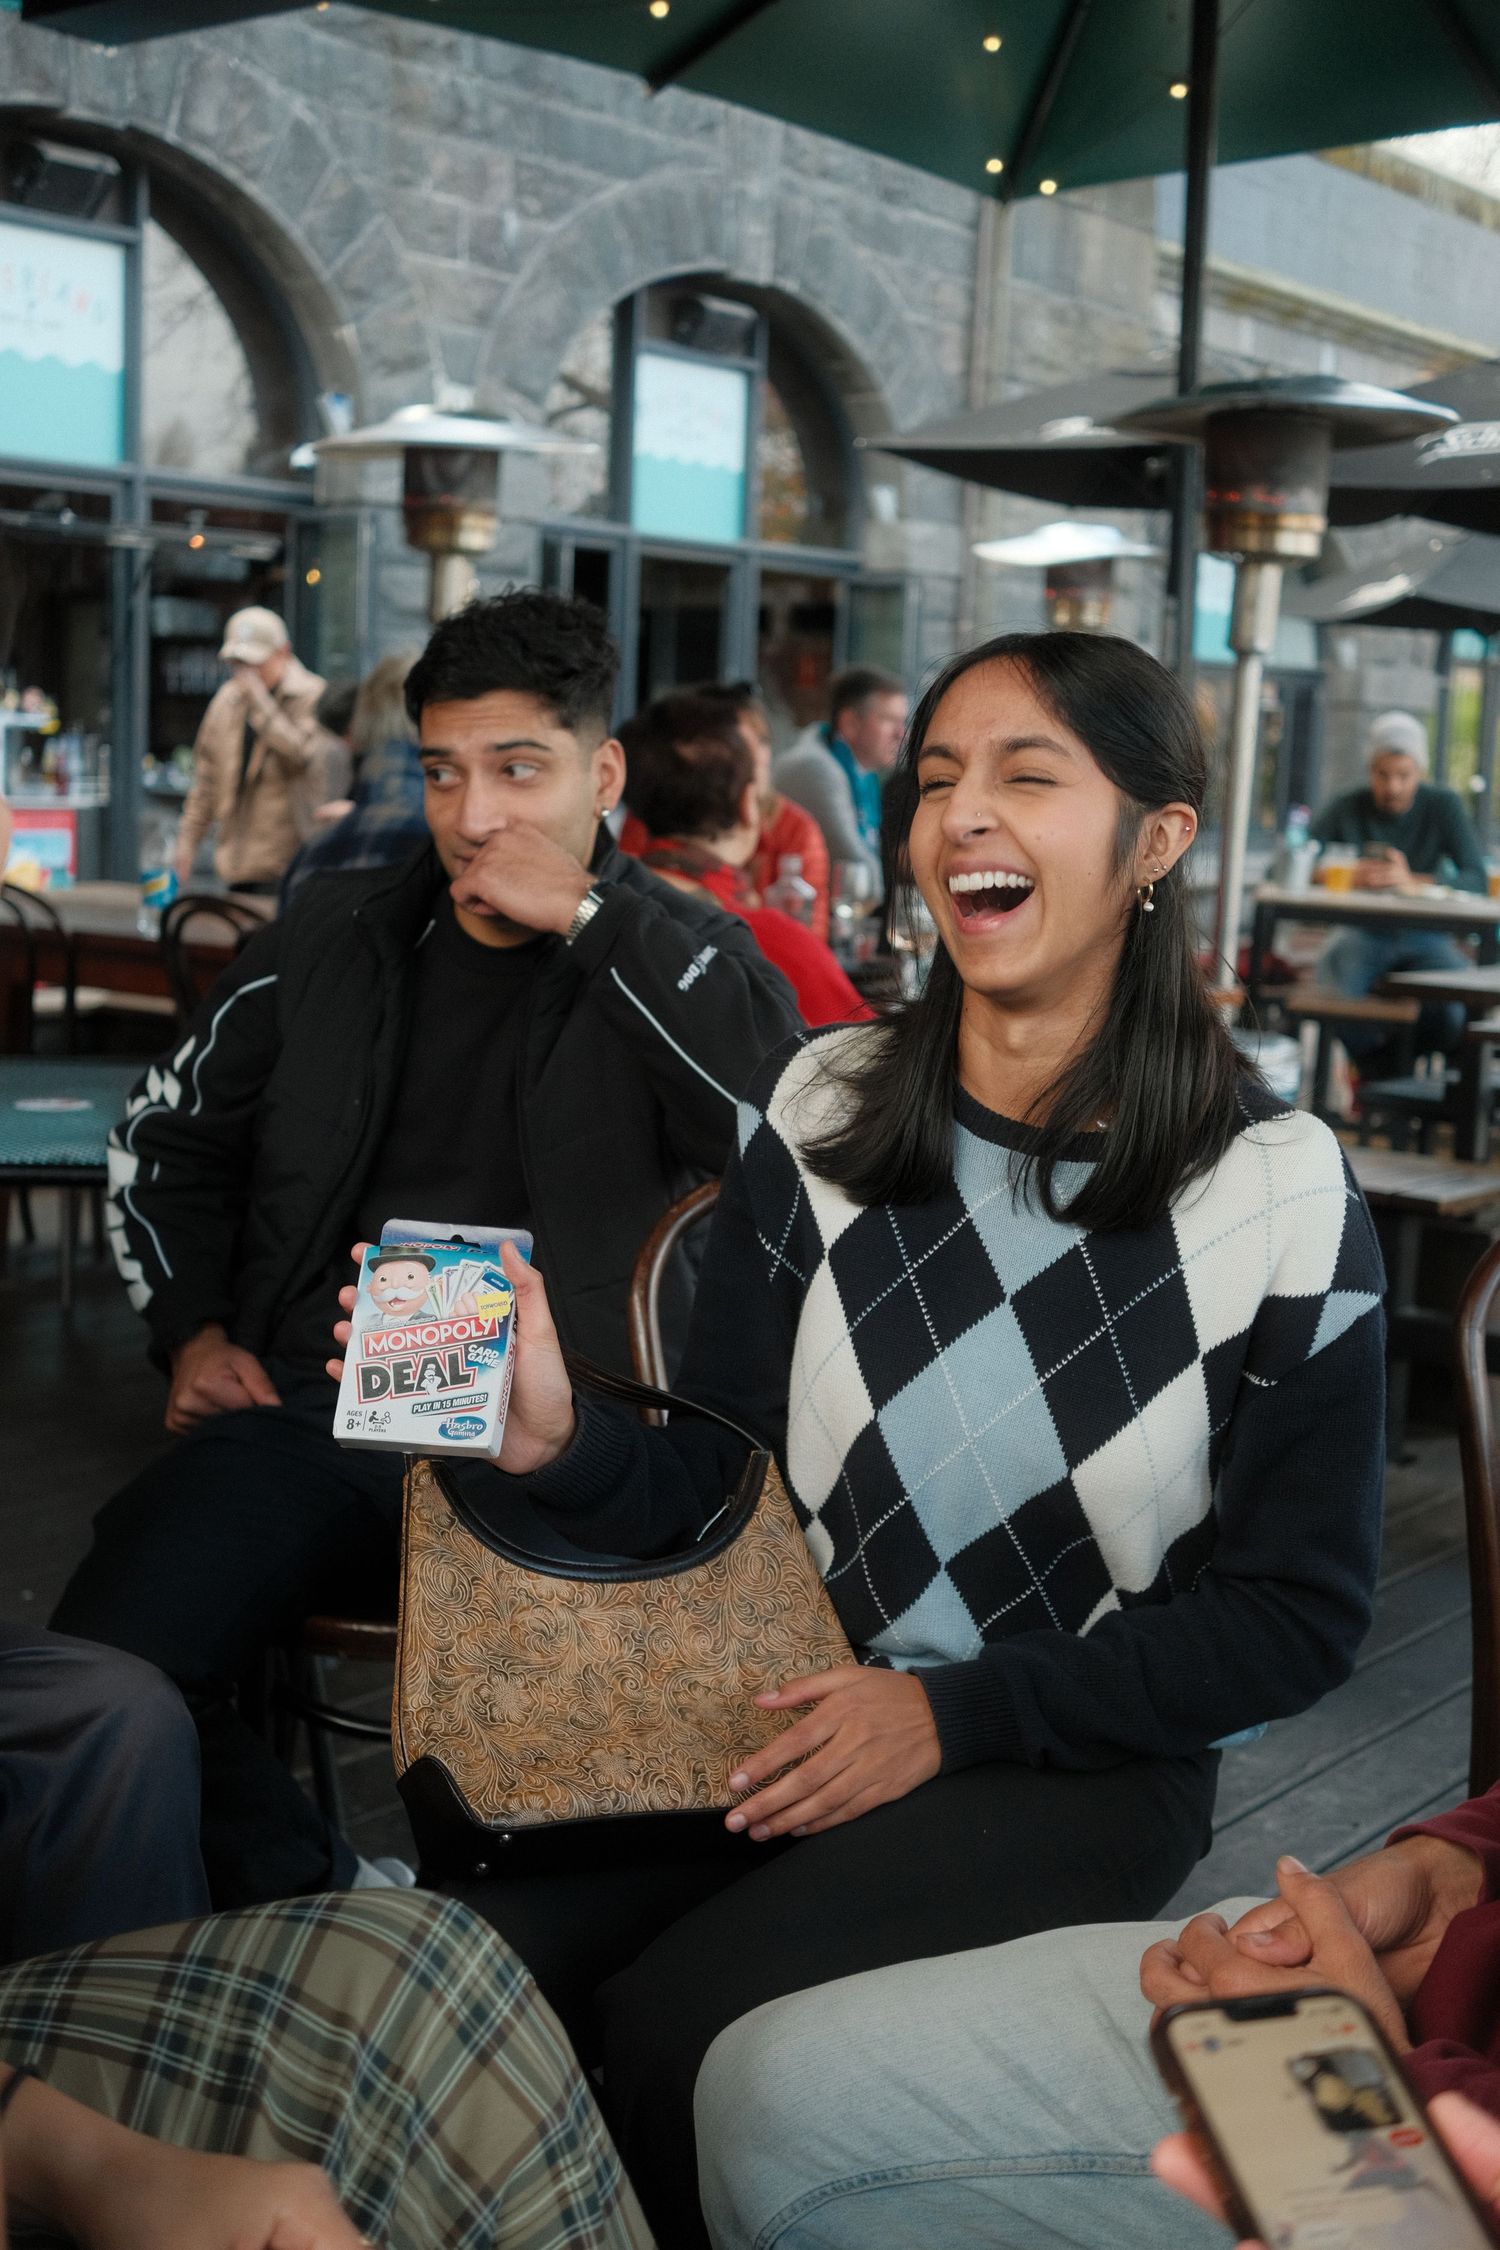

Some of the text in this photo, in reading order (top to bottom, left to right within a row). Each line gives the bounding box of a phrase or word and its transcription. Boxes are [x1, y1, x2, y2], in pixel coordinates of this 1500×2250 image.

[367, 1316, 495, 1354] MONOPOLY
[468, 1344, 499, 1358] CARD
[467, 1353, 500, 1368] GAME
[358, 1346, 474, 1401] DEAL
[413, 1393, 488, 1413] PLAY IN 15 MINUTES!
[346, 1418, 361, 1430] 8+
[443, 1417, 483, 1432] Hasbro
[447, 1427, 476, 1439] Gaming
